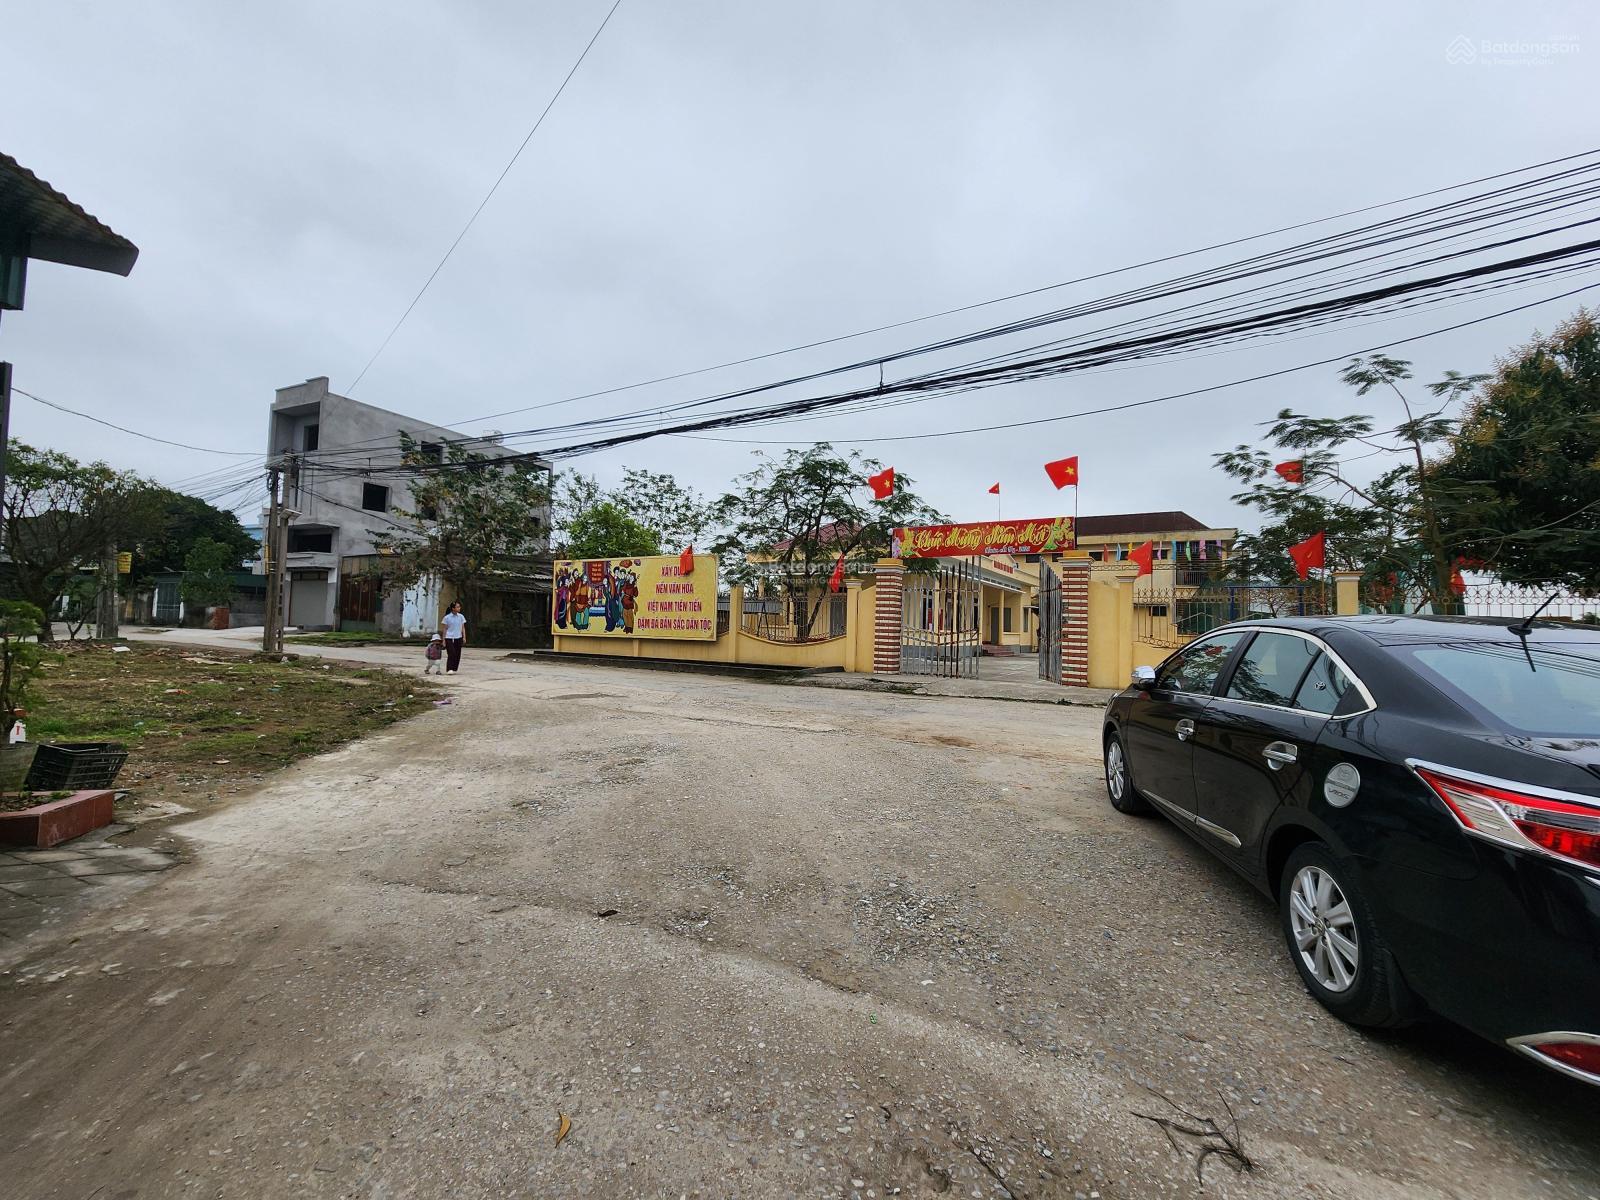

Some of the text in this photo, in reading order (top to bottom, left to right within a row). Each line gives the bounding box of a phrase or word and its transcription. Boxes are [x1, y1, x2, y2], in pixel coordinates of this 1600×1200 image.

[915, 529, 944, 551] Chúc
[647, 599, 659, 614] VIỆT
[659, 601, 673, 612] NAM
[672, 614, 686, 630] SẮC
[699, 617, 712, 633] TỘC
[1328, 787, 1351, 800] VIOS
